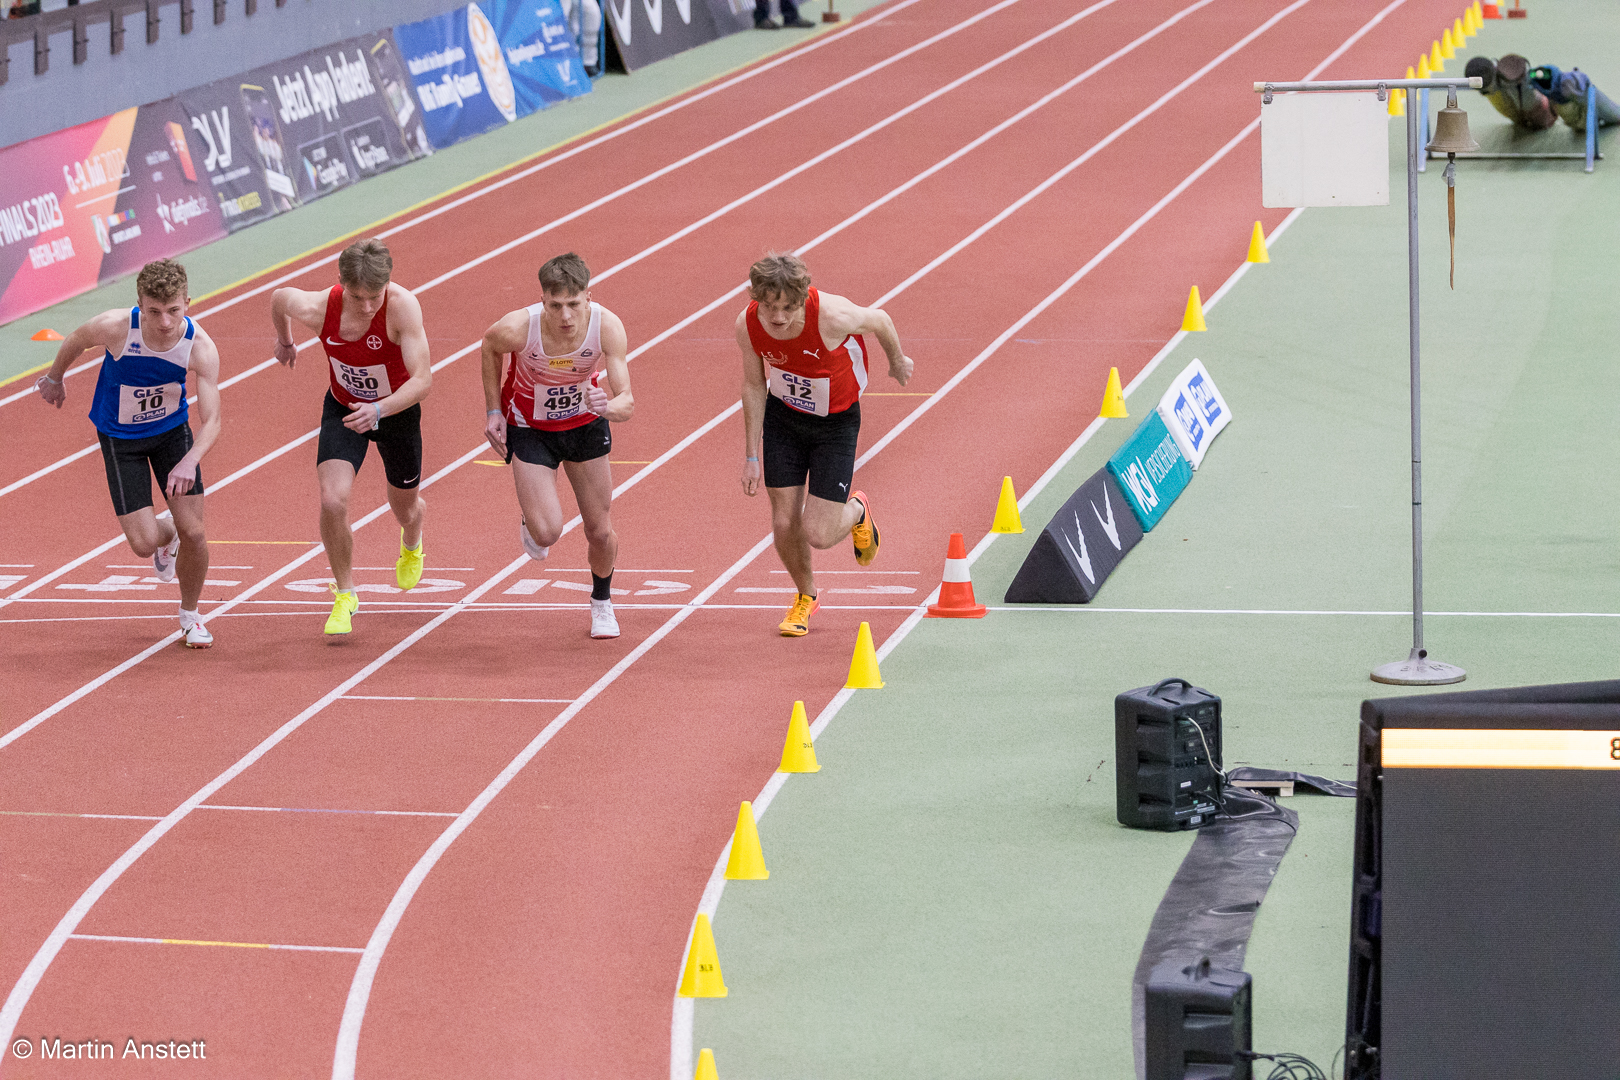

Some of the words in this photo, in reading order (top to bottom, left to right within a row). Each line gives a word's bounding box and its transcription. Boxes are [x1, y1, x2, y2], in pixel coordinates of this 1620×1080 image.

[272, 71, 315, 124] Jetzt
[303, 64, 340, 123] App
[325, 48, 377, 104] laden!
[31, 191, 65, 233] 2023
[340, 364, 369, 377] GLS
[341, 372, 379, 390] 450
[782, 373, 812, 388] GLS
[133, 387, 164, 399] GLS
[547, 385, 578, 397] GLS
[786, 383, 812, 400] 12
[137, 395, 163, 413] 10
[543, 391, 582, 411] 493
[796, 399, 814, 410] PLAN
[146, 408, 165, 418] PLAN
[561, 406, 580, 417] PLAN
